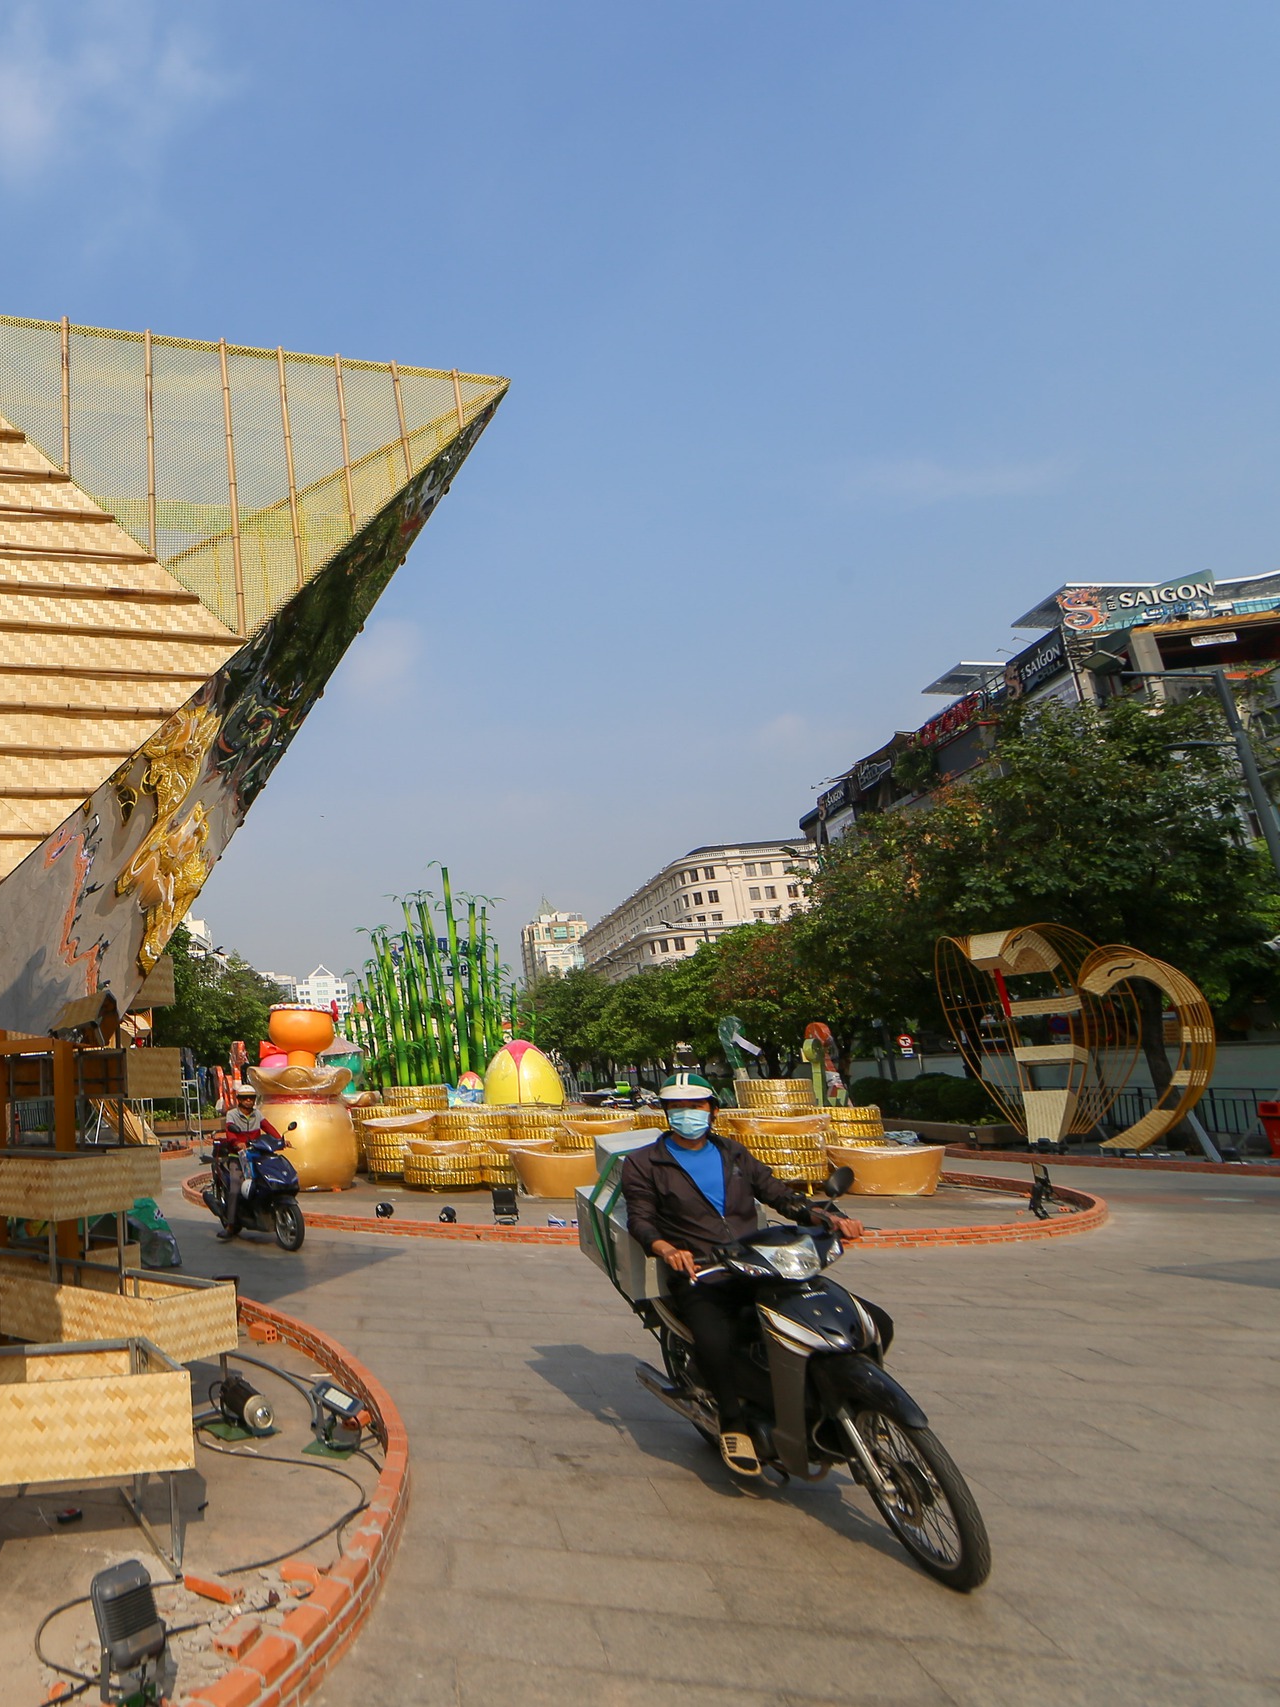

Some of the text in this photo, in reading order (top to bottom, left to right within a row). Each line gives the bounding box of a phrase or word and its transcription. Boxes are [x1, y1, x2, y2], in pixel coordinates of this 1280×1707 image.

[1106, 582, 1215, 612] BIA SAIGON
[1025, 643, 1061, 678] SAIGON
